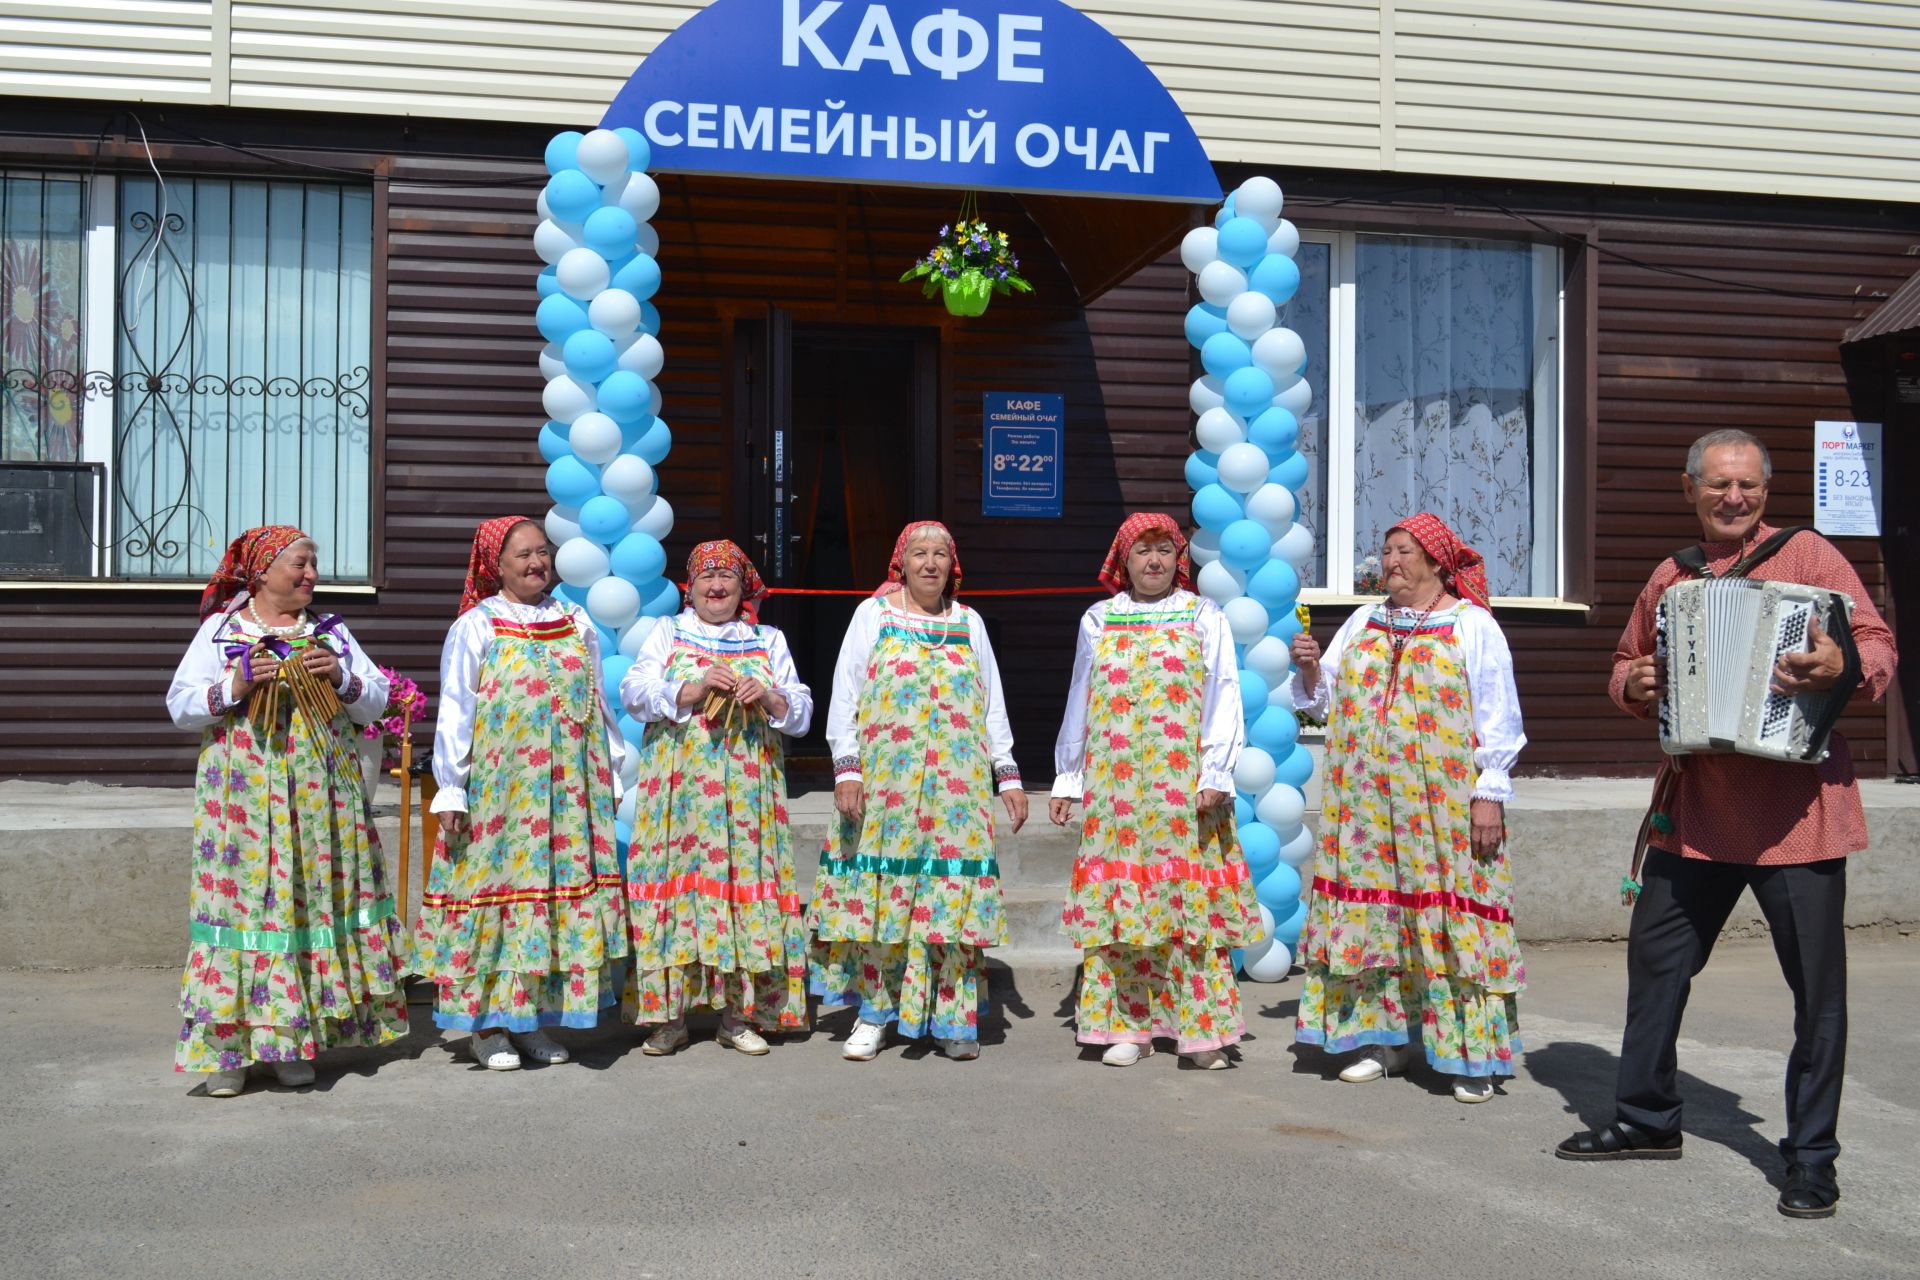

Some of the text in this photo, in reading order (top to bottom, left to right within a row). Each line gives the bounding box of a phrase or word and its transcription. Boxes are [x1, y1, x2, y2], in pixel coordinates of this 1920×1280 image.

[781, 0, 1045, 84] КАФЕ
[643, 98, 1170, 174] СЕМЕЙНЫЙ ОЧАГ
[990, 413, 1035, 421] СЕМЕЙНЫЙ
[1007, 400, 1041, 410] КАФЕ
[1835, 469, 1872, 488] 8-23
[1687, 625, 1696, 675] ТУЛА
